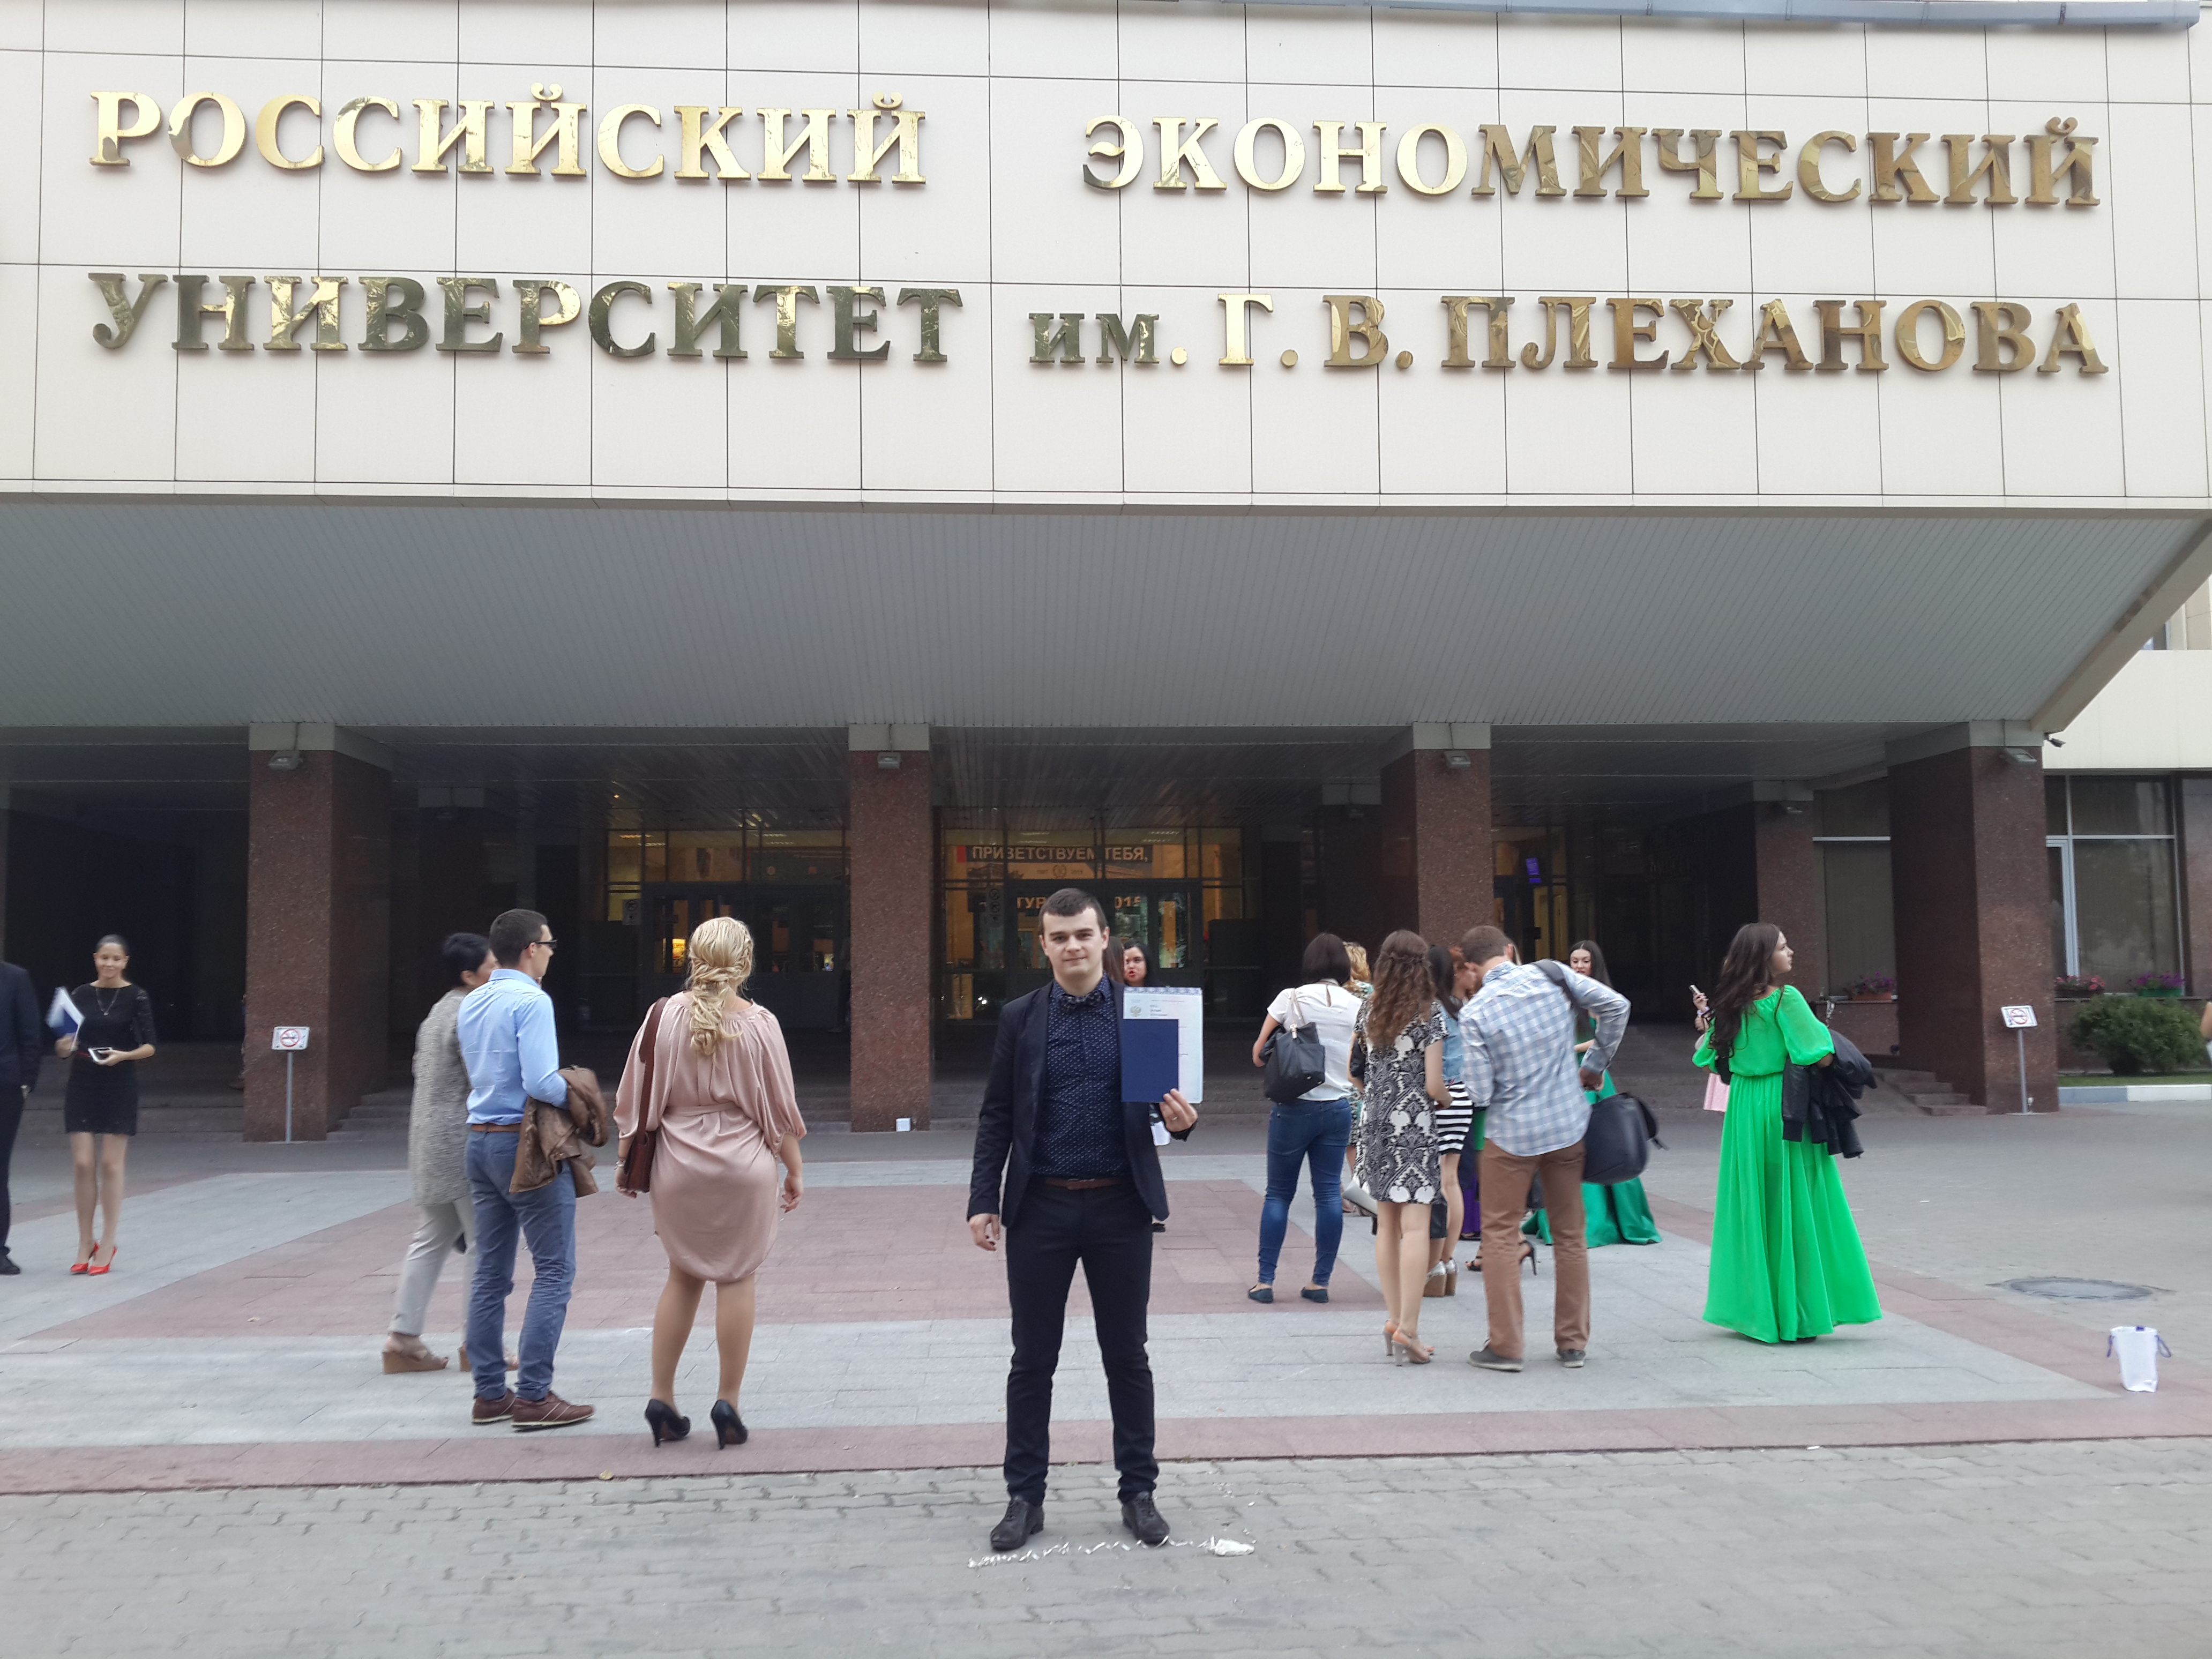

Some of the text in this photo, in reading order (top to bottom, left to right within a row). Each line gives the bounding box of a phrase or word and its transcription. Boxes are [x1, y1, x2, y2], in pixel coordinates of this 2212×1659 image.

[89, 83, 2101, 206] РОССИЙСКИЙ ЭКОНОМИЧЕСКИЙ
[86, 272, 965, 363] УНИВЕРСИТЕТ
[1028, 312, 1188, 367] им.
[1439, 294, 2110, 374] ПЛЕХАНОВА
